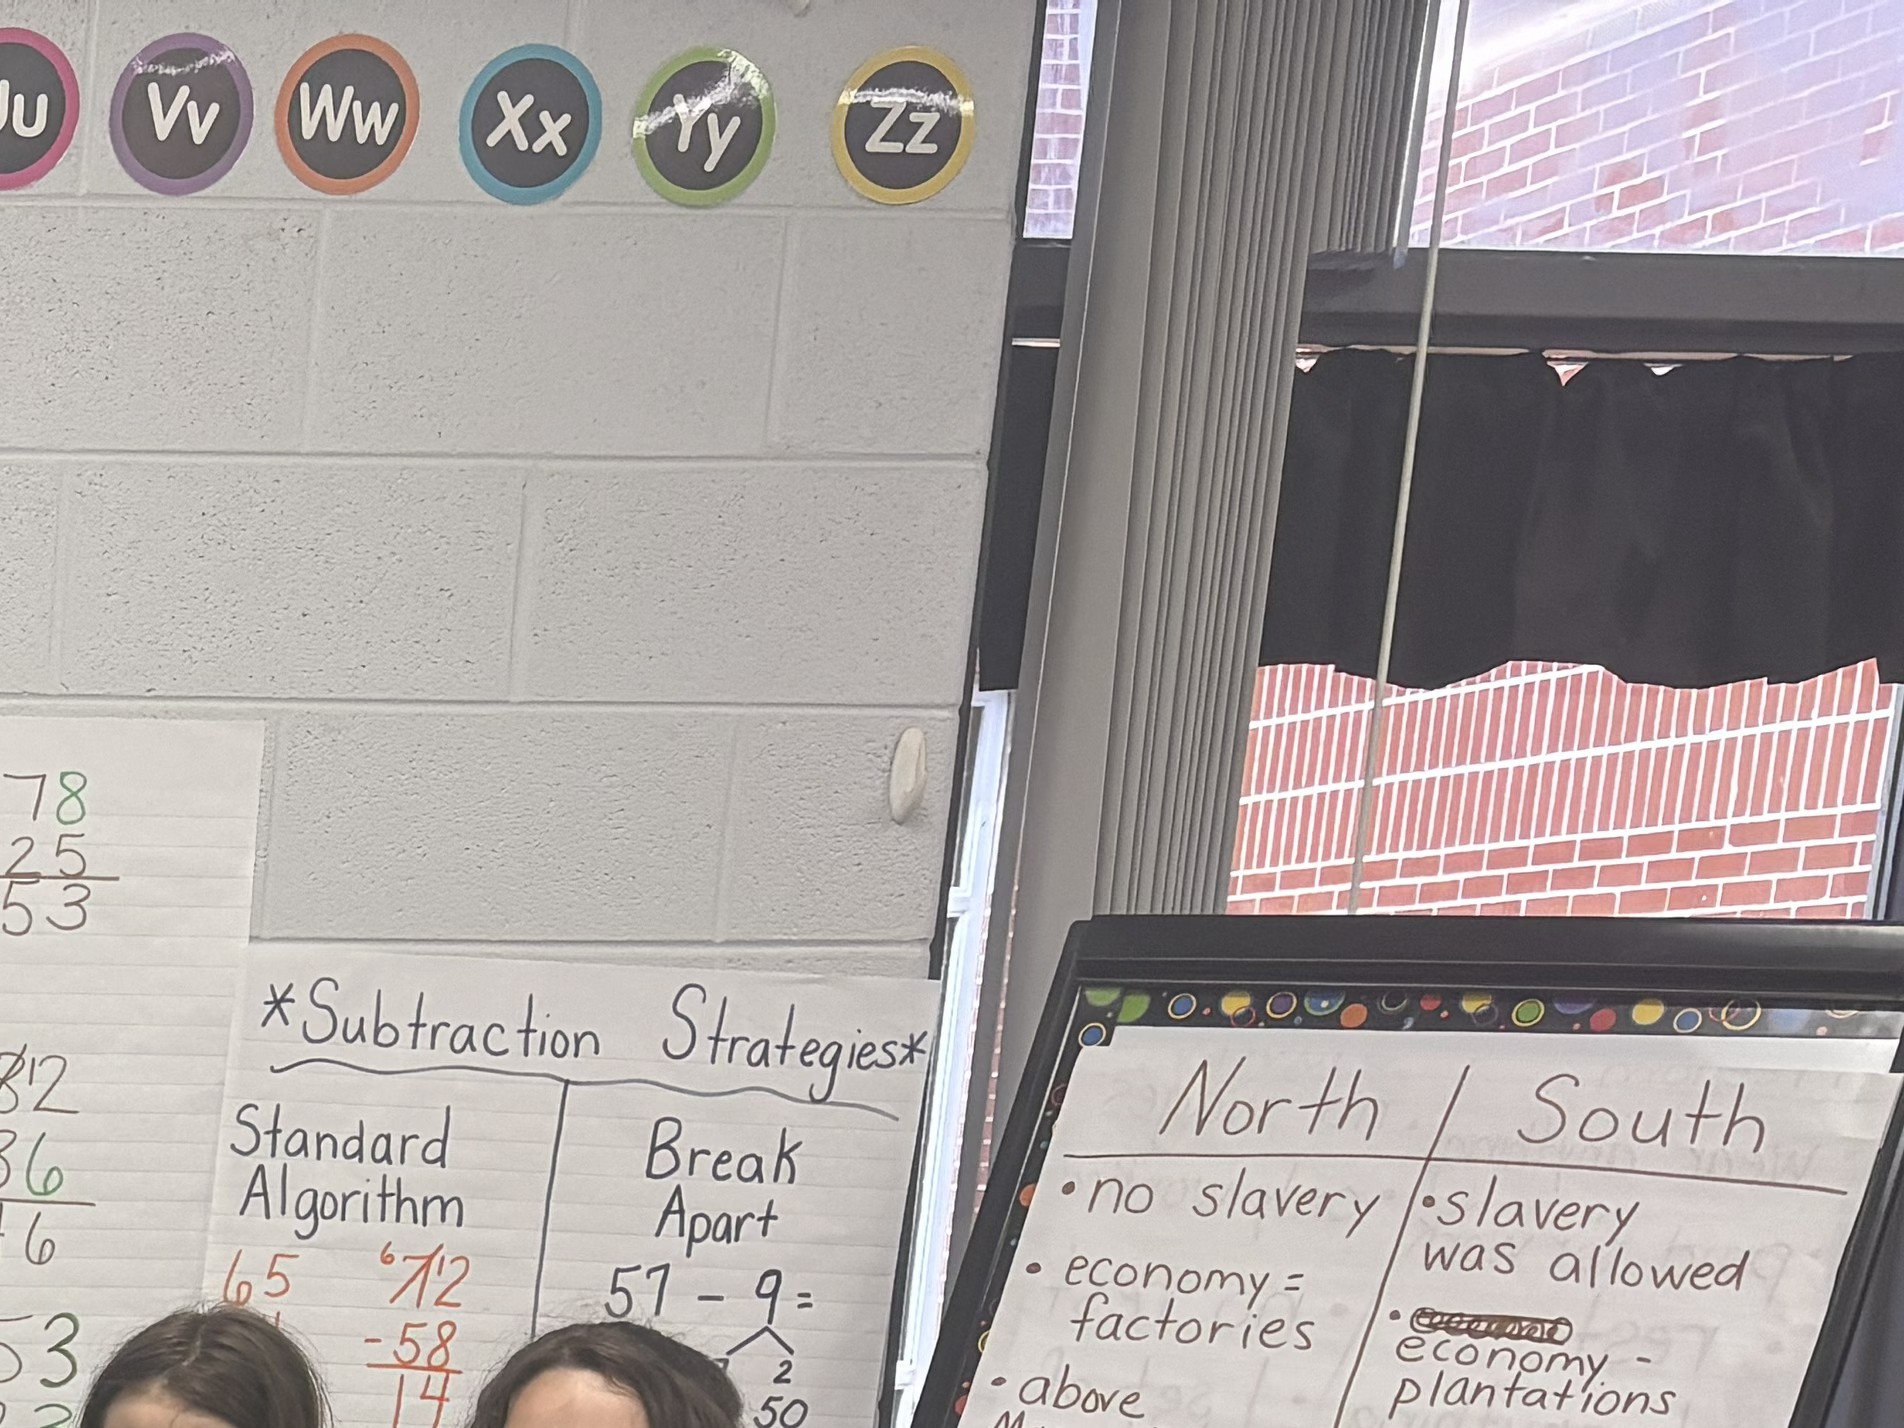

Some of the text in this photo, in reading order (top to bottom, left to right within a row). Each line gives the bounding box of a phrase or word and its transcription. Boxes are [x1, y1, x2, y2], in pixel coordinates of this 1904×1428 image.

[147, 82, 218, 141] Vv
[300, 86, 397, 145] Ww
[487, 94, 567, 157] Xx
[674, 96, 740, 171] Yy
[866, 97, 939, 155] Zz
[4, 771, 88, 824] 78
[2, 879, 89, 935] 53
[229, 1103, 450, 1167] Standard
[1159, 1057, 1769, 1154] North South
[645, 1117, 803, 1184] Break
[239, 1164, 464, 1240] Algorithm
[654, 1184, 778, 1257] Apart
[1087, 1170, 1380, 1238] no slavery
[1434, 1191, 1638, 1249] slavery
[1423, 1238, 1748, 1292] was allowed
[1070, 1289, 1316, 1353] factories
[1396, 1339, 1607, 1390] economy
[754, 1396, 808, 1428] 50
[1020, 1375, 1142, 1420] above
[1388, 1371, 1678, 1420] plantations
